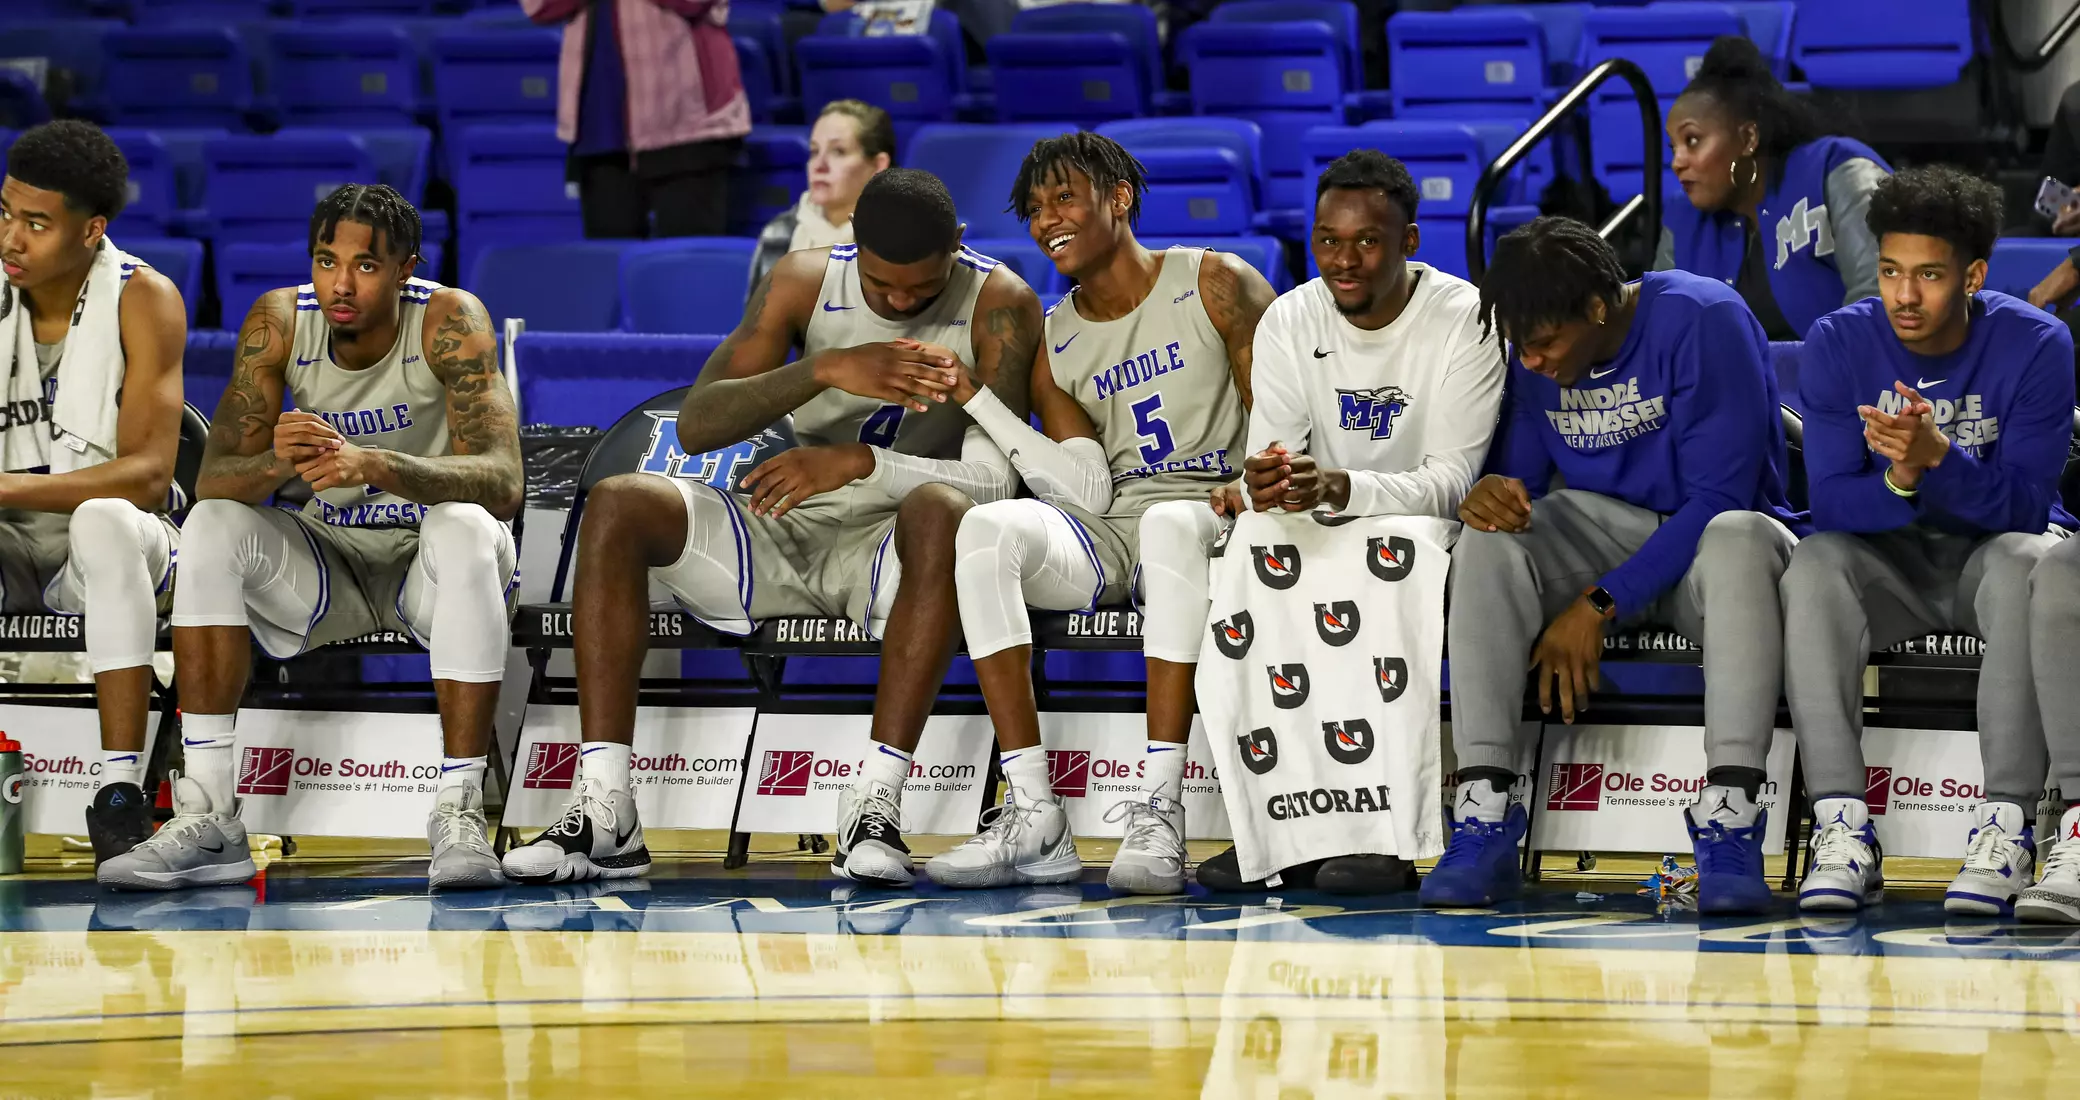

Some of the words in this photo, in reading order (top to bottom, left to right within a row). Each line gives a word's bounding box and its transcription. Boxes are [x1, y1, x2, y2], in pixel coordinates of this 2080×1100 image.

[1776, 196, 1835, 270] MT
[1092, 340, 1186, 401] MIDDLE
[1337, 391, 1404, 440] MT
[857, 402, 908, 451] 4
[1128, 390, 1177, 466] 5
[1563, 434, 1595, 449] MEN'S
[635, 414, 758, 492] MT
[776, 619, 828, 642] BLUE
[1067, 611, 1120, 636] BLUE
[24, 752, 102, 776] South.c
[294, 757, 333, 777] Ole
[338, 758, 442, 779] South.co
[813, 759, 851, 778] Ole
[1091, 759, 1131, 778] Ole
[58, 780, 89, 790] Home
[293, 780, 361, 792] Tennessee's
[364, 783, 378, 792] #1
[382, 783, 414, 793] Home
[417, 784, 438, 794] Buil
[645, 776, 659, 785] #1
[662, 775, 694, 786] Home
[696, 776, 735, 786] Builder
[935, 782, 973, 792] Builder
[1181, 784, 1214, 793] Home
[1604, 773, 1645, 792] Ole
[1893, 776, 1934, 797] Ole
[1604, 796, 1675, 807] Tennessee's
[1678, 798, 1692, 807] #1
[1892, 800, 1965, 813] Tennessee's
